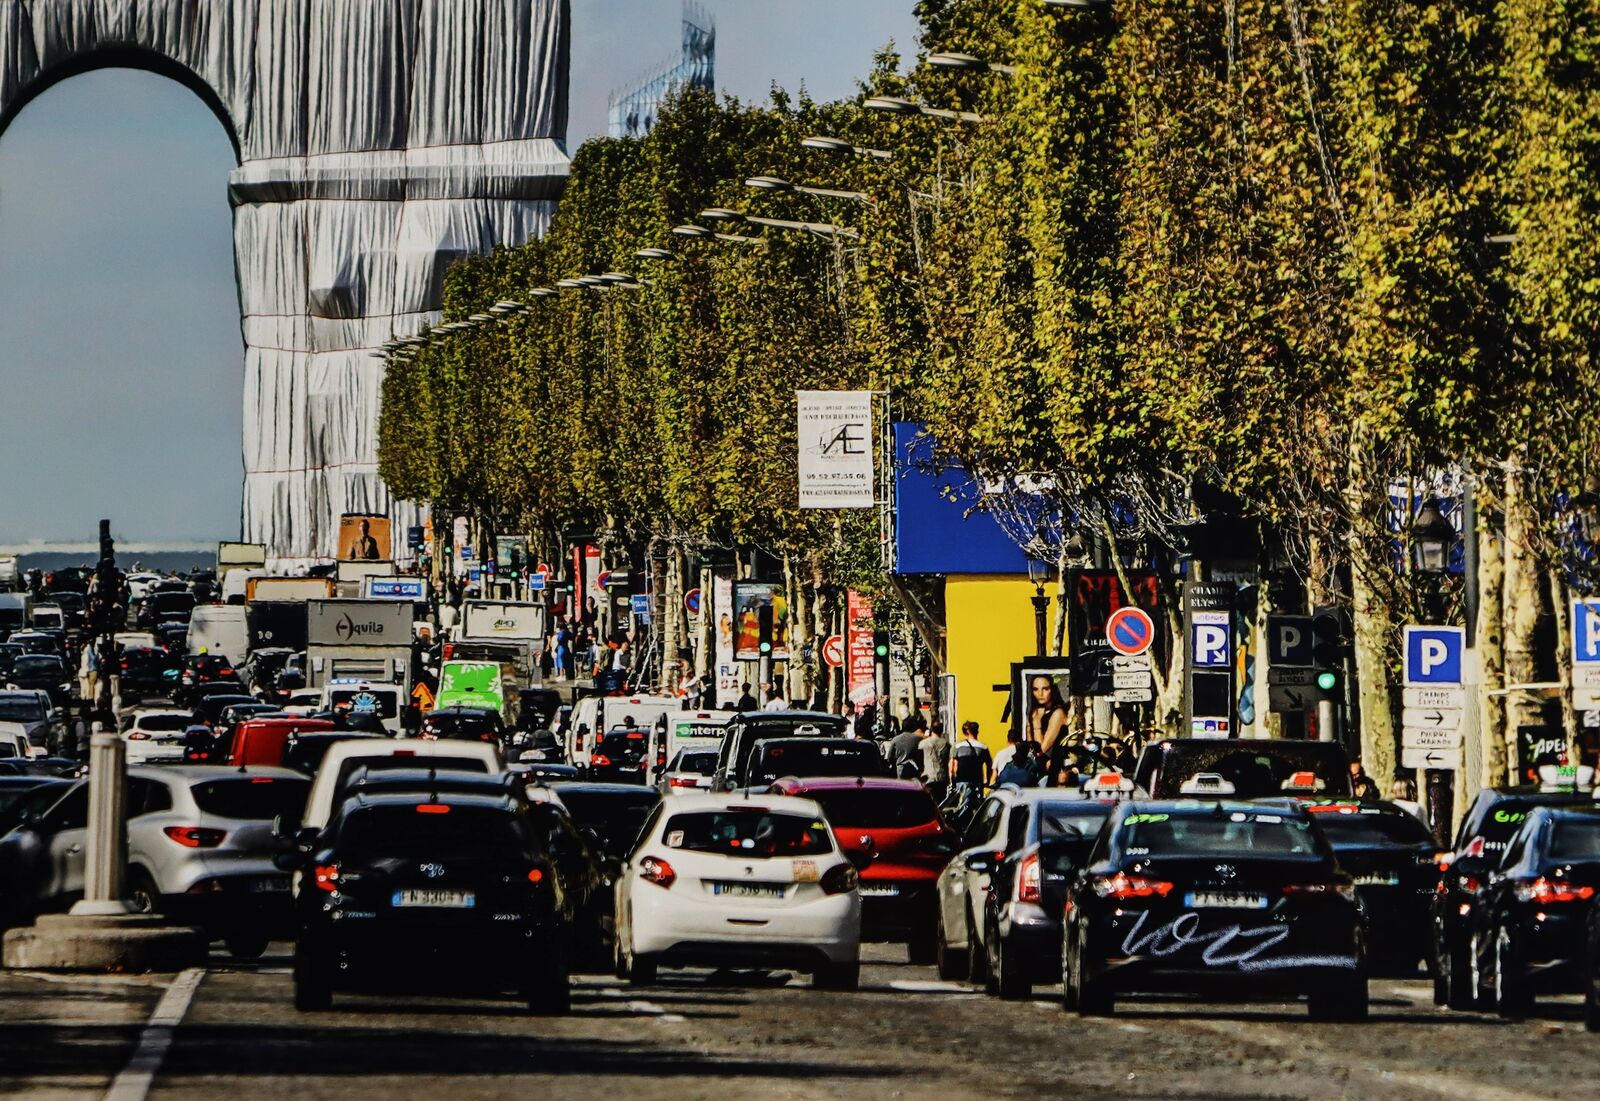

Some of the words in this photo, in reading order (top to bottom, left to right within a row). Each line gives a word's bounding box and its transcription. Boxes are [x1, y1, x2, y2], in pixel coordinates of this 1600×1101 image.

[373, 585, 393, 593] RENT
[401, 585, 418, 593] CAR
[336, 612, 383, 641] Aquila
[1279, 626, 1300, 657] P
[1196, 625, 1226, 663] P
[1421, 638, 1448, 675] P
